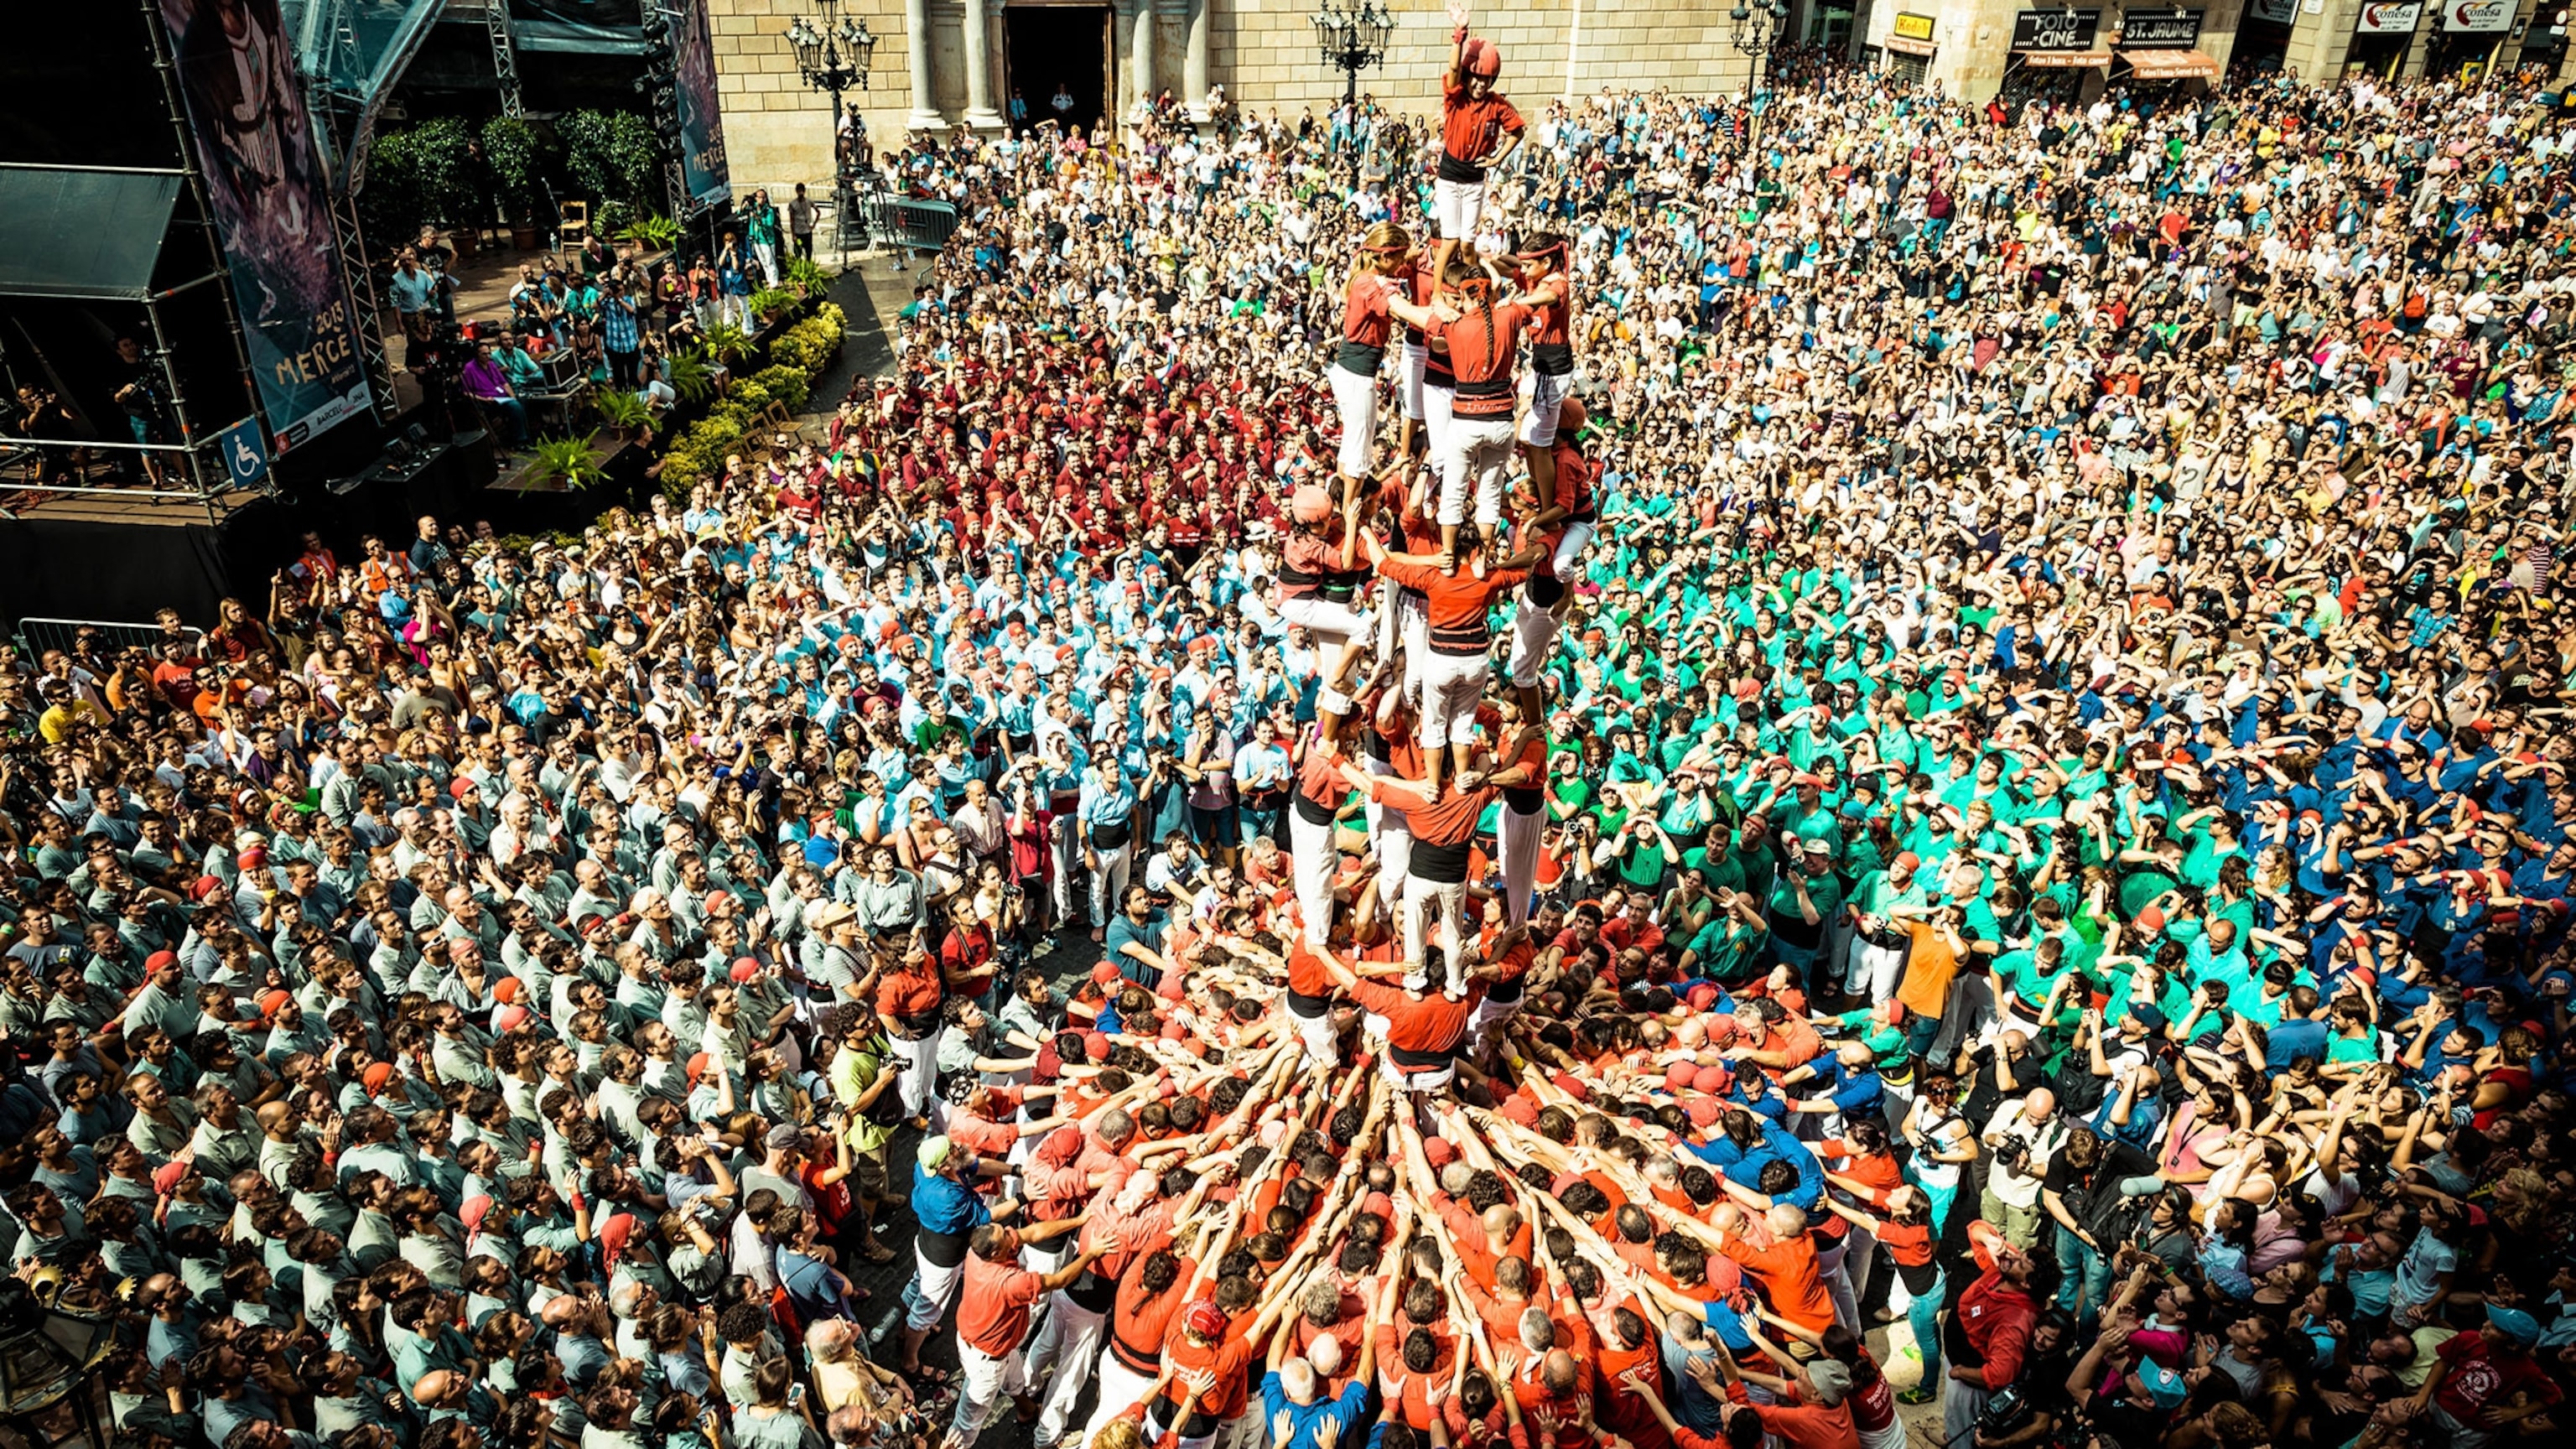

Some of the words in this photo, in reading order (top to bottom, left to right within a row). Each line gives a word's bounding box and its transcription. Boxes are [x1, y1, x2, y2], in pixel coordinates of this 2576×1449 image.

[2375, 10, 2412, 18] conesa
[2465, 8, 2501, 17] conesa
[2034, 13, 2079, 30] FOTO
[2038, 30, 2077, 47] CINE
[2126, 22, 2147, 39] ST.
[2148, 22, 2196, 39] JAUME
[316, 300, 345, 335] 2013
[2288, 423, 2304, 439] 79
